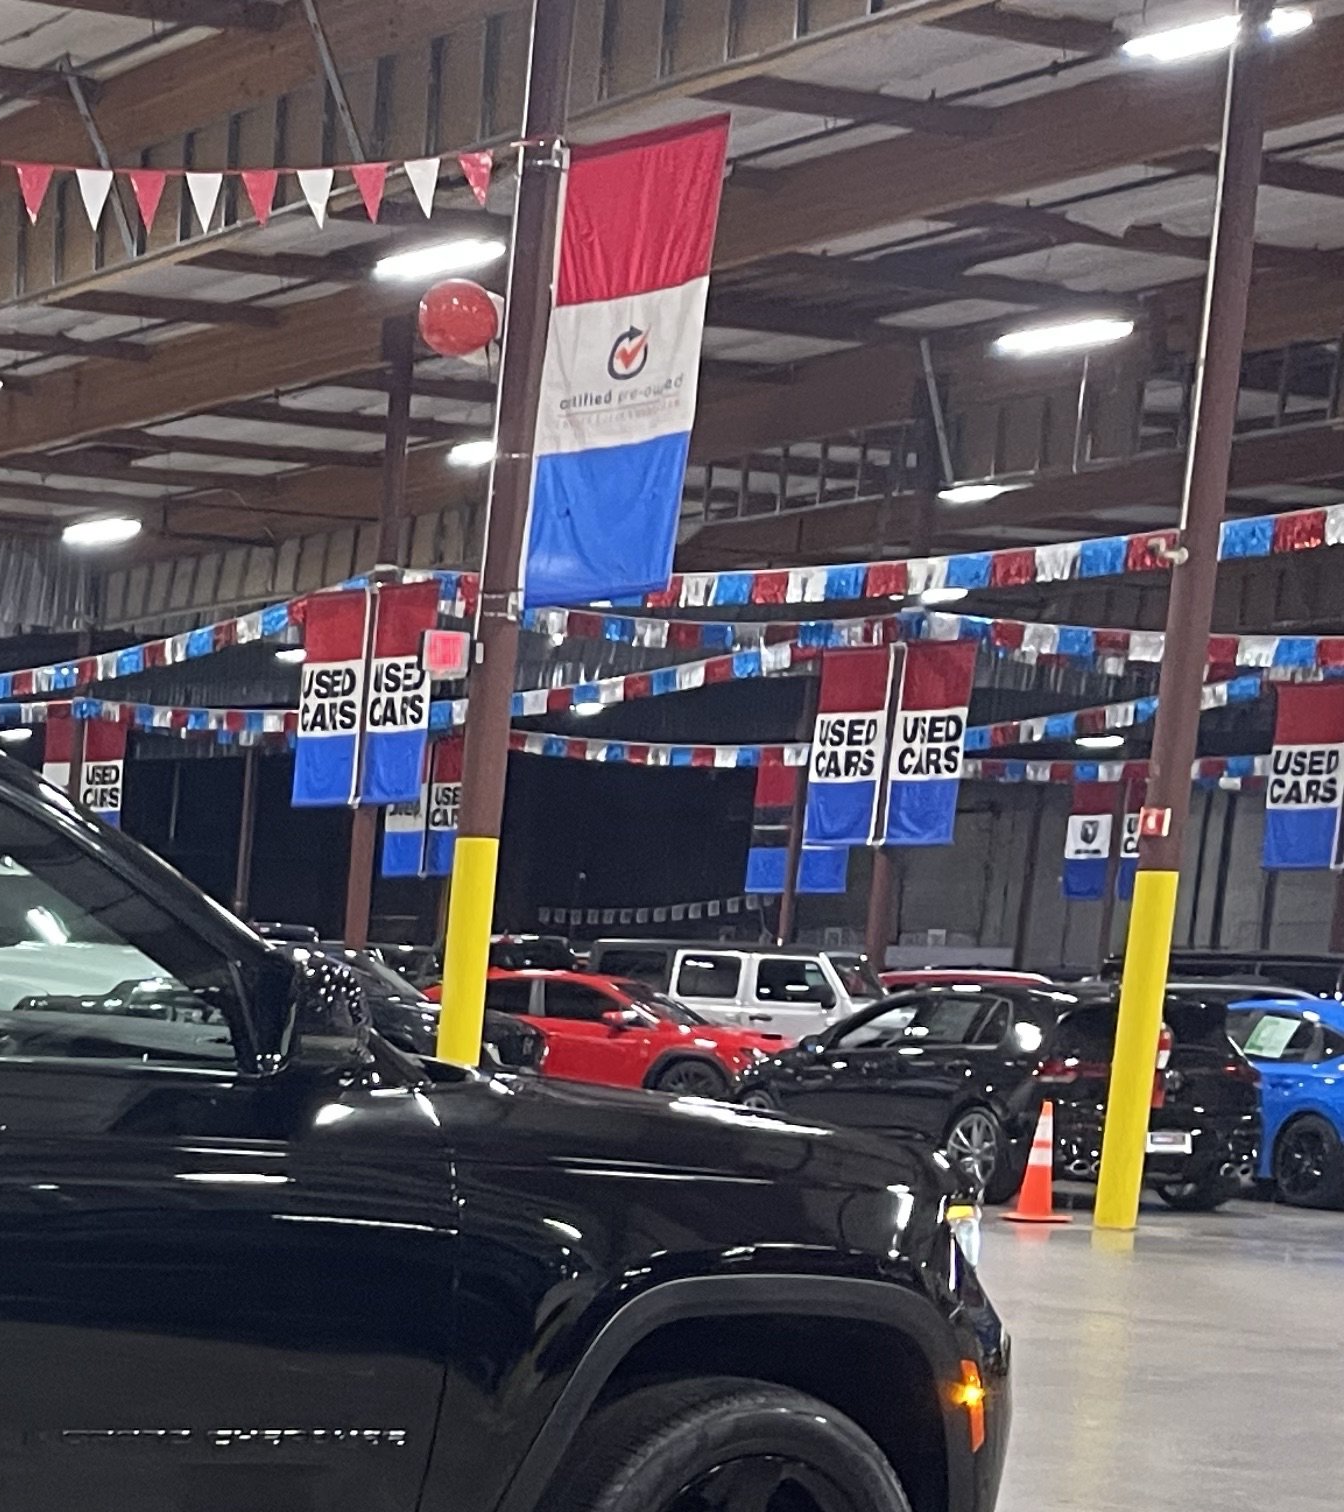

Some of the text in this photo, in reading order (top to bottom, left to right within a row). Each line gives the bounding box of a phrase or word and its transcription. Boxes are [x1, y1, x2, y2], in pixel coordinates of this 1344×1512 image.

[302, 668, 357, 698] USED
[374, 663, 425, 693] USED
[301, 700, 357, 731] CARS
[370, 695, 424, 726] CARS
[819, 719, 878, 746] USED
[903, 715, 962, 744] USED
[86, 765, 119, 785] USED
[815, 749, 875, 778] CARS
[898, 746, 960, 775] CARS
[1273, 750, 1339, 776] USED
[83, 787, 119, 808] CARS
[435, 787, 461, 805] USE
[1269, 778, 1338, 804] CARS
